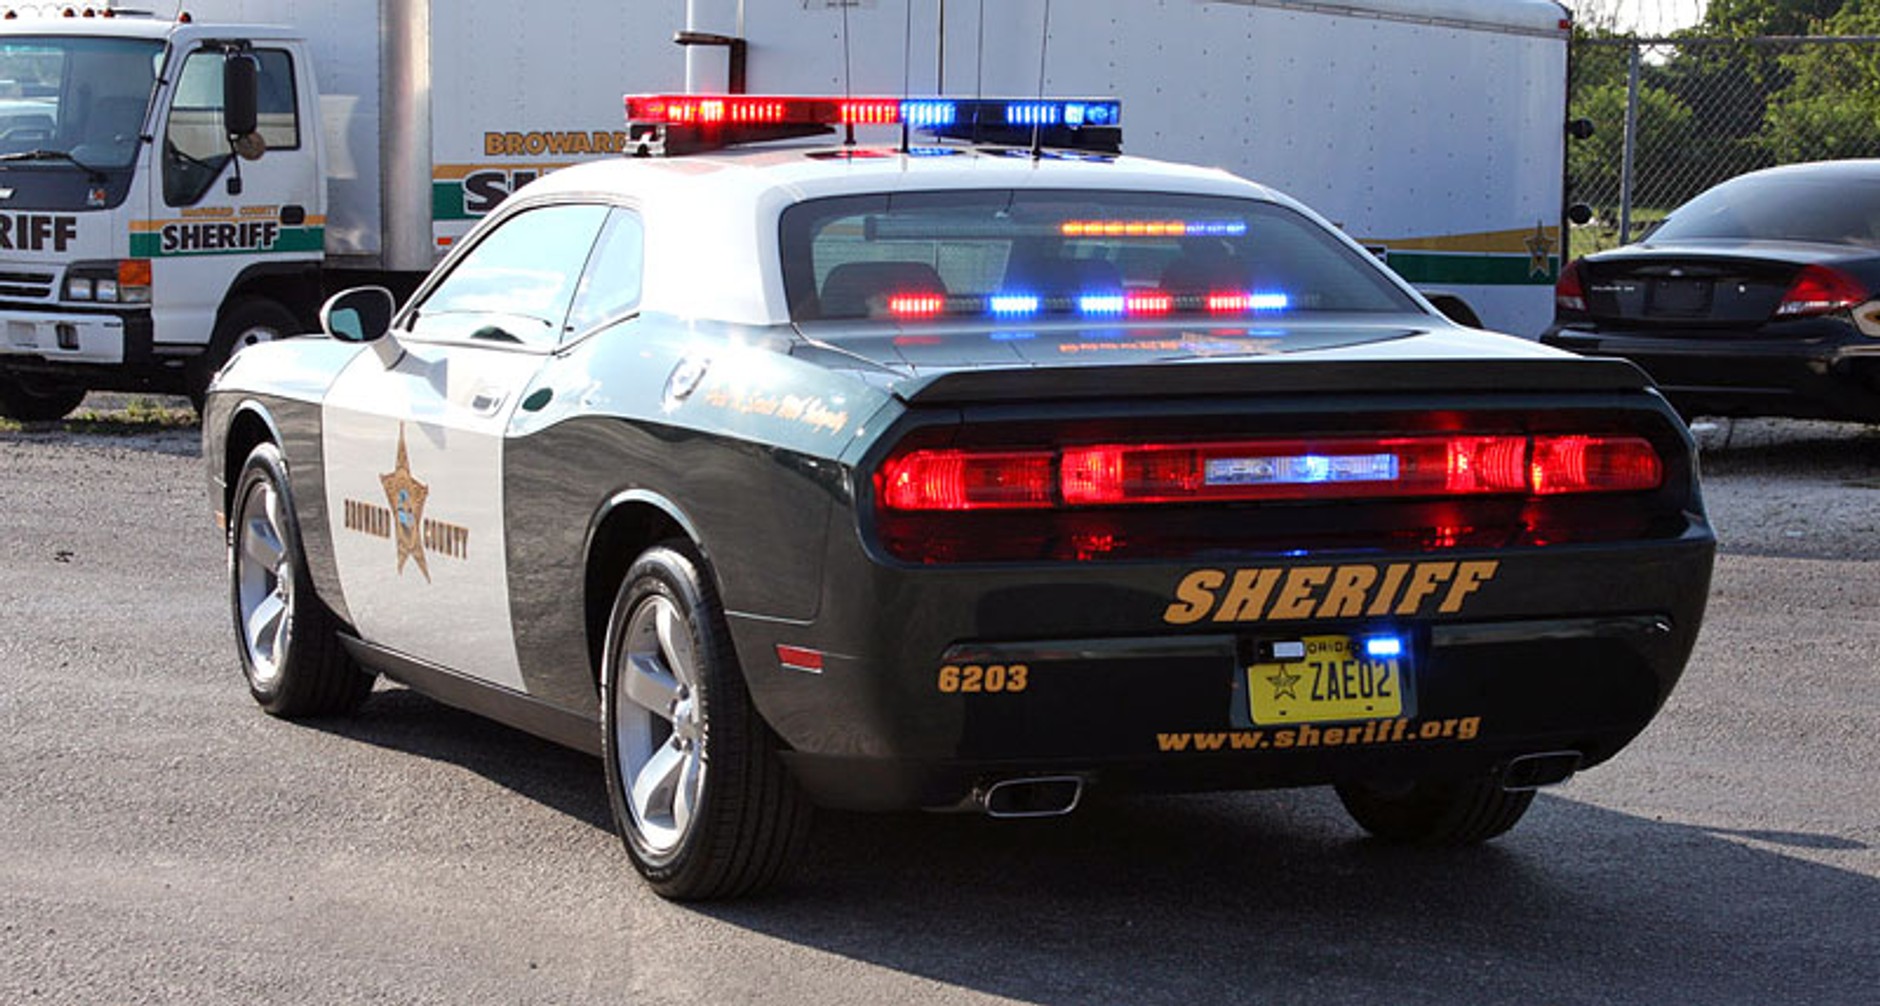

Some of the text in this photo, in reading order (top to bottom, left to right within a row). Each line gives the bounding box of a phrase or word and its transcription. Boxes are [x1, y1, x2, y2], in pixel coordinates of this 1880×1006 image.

[484, 131, 626, 155] BROWARD
[161, 221, 278, 251] SHERIFF
[344, 498, 469, 560] BROWARD COUNTY
[1163, 560, 1499, 624] SHERIFF
[938, 664, 1029, 692] 6203
[1157, 716, 1481, 752] www.sheriff.org
